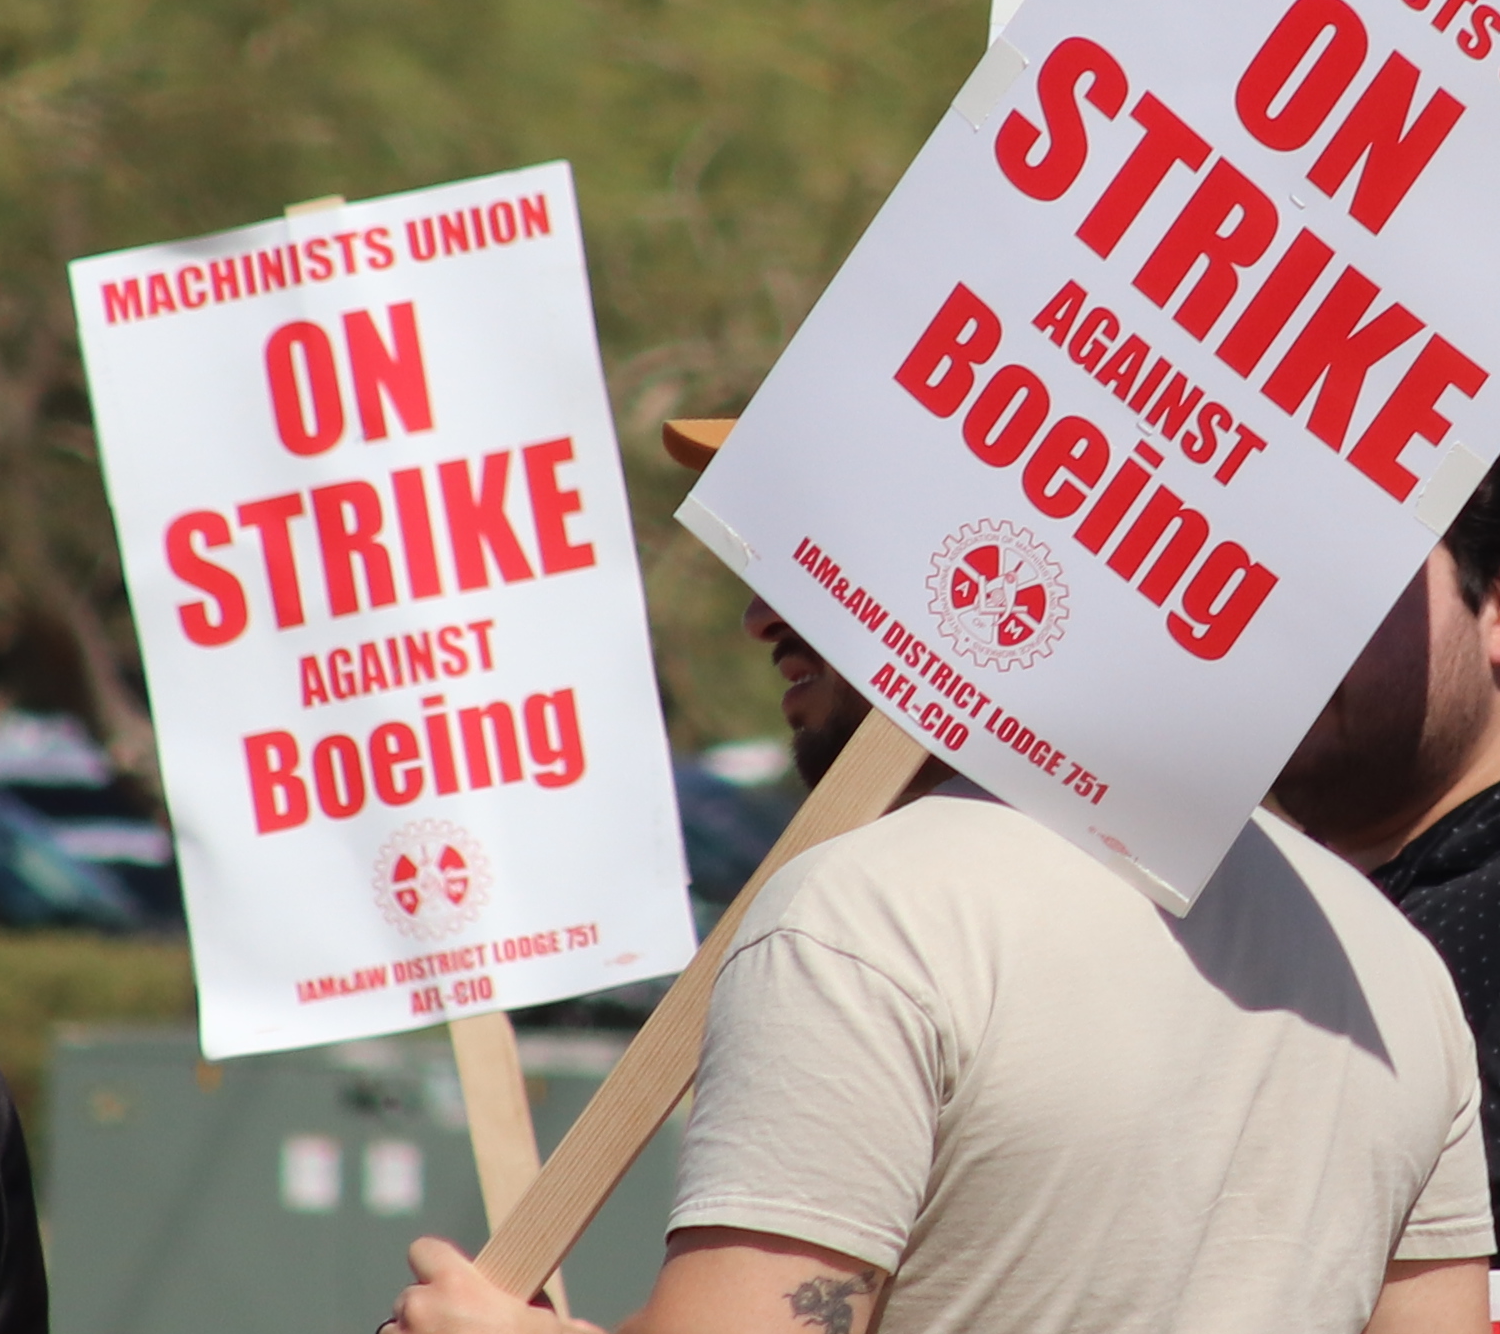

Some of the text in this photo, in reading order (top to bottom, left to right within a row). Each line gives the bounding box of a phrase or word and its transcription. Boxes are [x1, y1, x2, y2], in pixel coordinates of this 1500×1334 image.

[103, 194, 551, 324] MACHINISTS UNION
[995, 37, 1490, 502] STRIKE
[265, 301, 434, 458] ON
[1033, 281, 1267, 485] AGAINST
[165, 436, 596, 648] STRIKE
[894, 283, 1279, 661] Boeing
[301, 619, 494, 707] AGAINST
[792, 536, 1110, 806] IAM&AW DISTRICT LODGE 751
[869, 662, 970, 752] AFL-CIO
[244, 688, 586, 835] Boeing
[296, 924, 598, 1004] IAM&AW DISTRICT LODGE 751
[411, 976, 494, 1016] AFL-CIO
